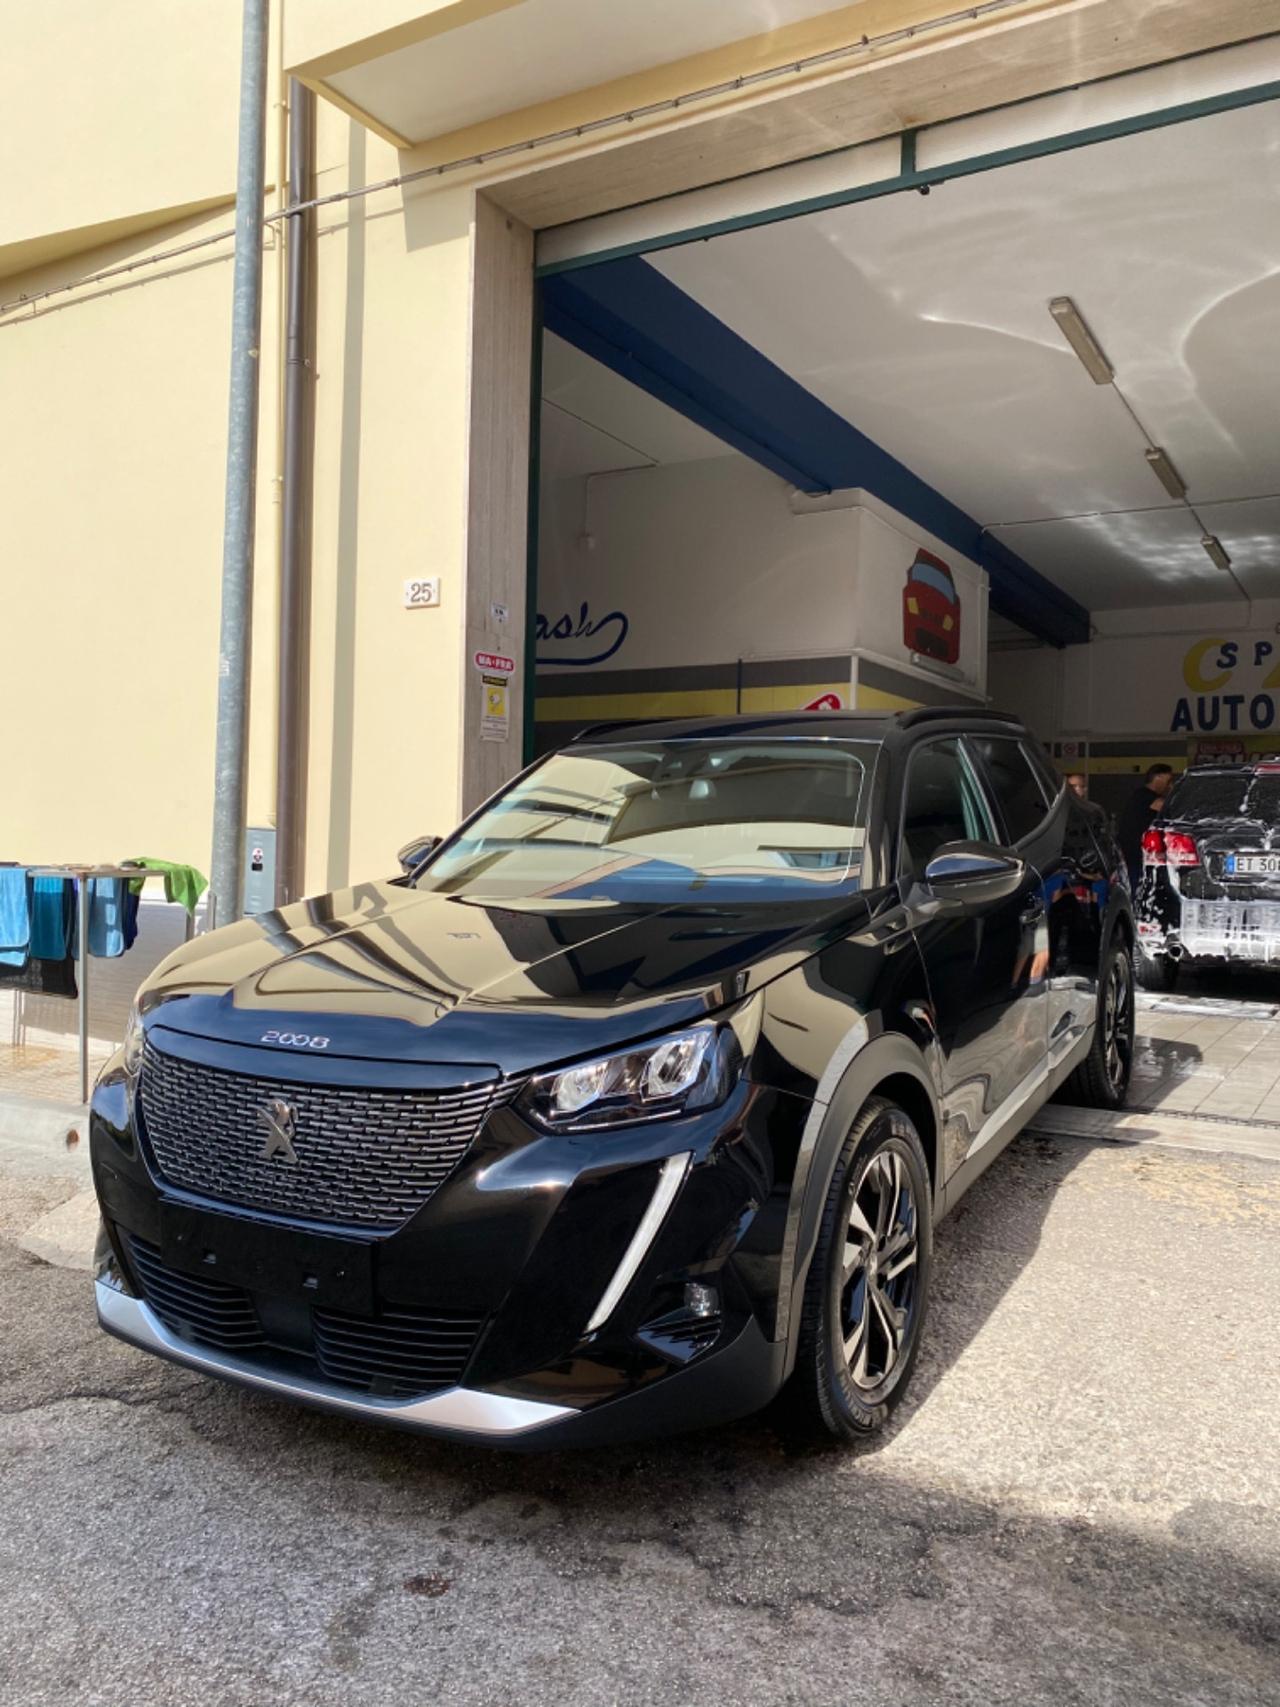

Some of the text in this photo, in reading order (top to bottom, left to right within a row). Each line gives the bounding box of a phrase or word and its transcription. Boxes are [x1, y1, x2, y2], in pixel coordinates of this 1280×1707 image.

[411, 582, 432, 602] 25
[1171, 694, 1276, 732] AUTO
[1237, 858, 1253, 871] ET
[261, 1030, 330, 1049] 2008
